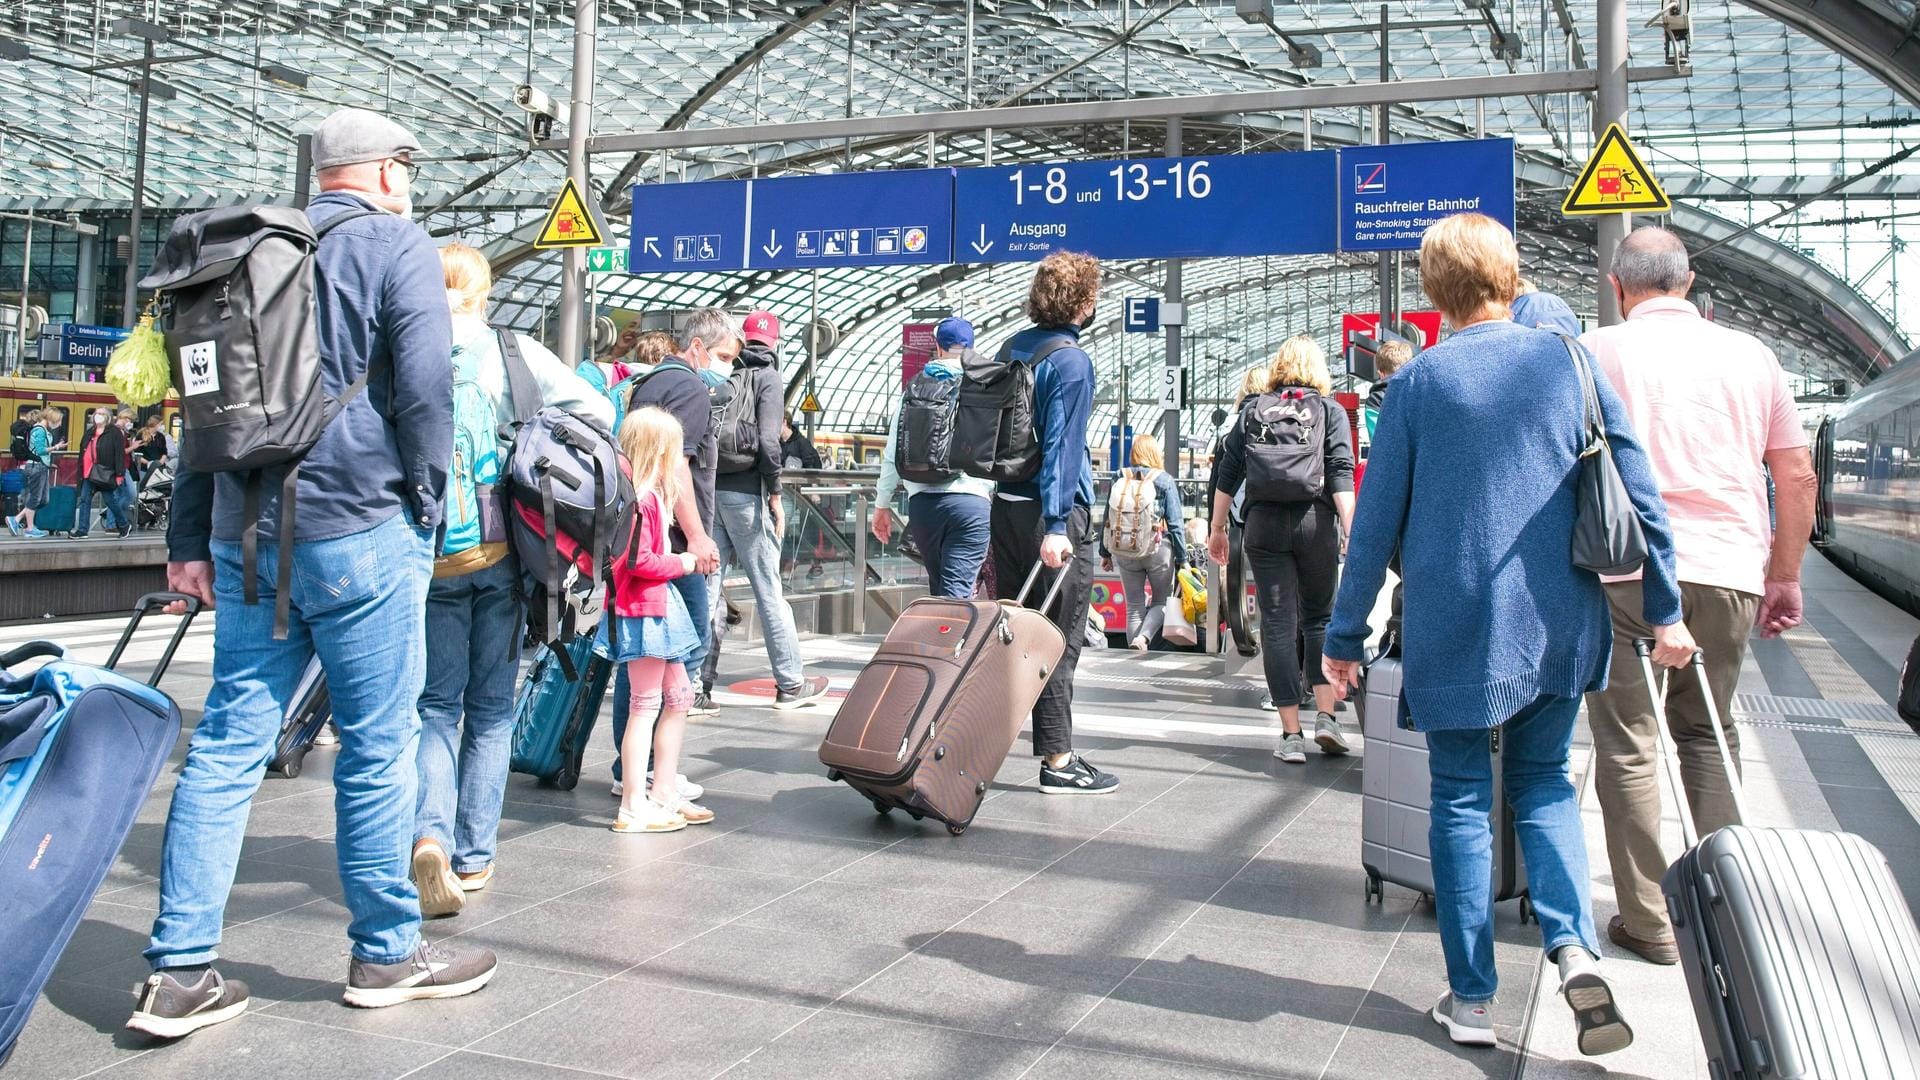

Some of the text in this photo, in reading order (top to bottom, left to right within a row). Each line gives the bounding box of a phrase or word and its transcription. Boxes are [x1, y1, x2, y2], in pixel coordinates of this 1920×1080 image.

[1009, 160, 1212, 205] 1-8 und 13-16
[1355, 197, 1480, 214] Rauchfreier Bahnhof
[1009, 221, 1067, 238] Ausgang
[1355, 219, 1411, 229] Non-Smoking
[1355, 231, 1375, 240] Gare
[1008, 243, 1023, 251] Exit
[1028, 242, 1050, 250] Sortie
[1129, 299, 1146, 325] E
[96, 328, 112, 337] Europa
[69, 342, 102, 357] Berlin
[192, 377, 211, 386] WWF
[1165, 370, 1175, 385] 5
[1165, 388, 1175, 403] 4
[223, 401, 251, 411] VAUDE
